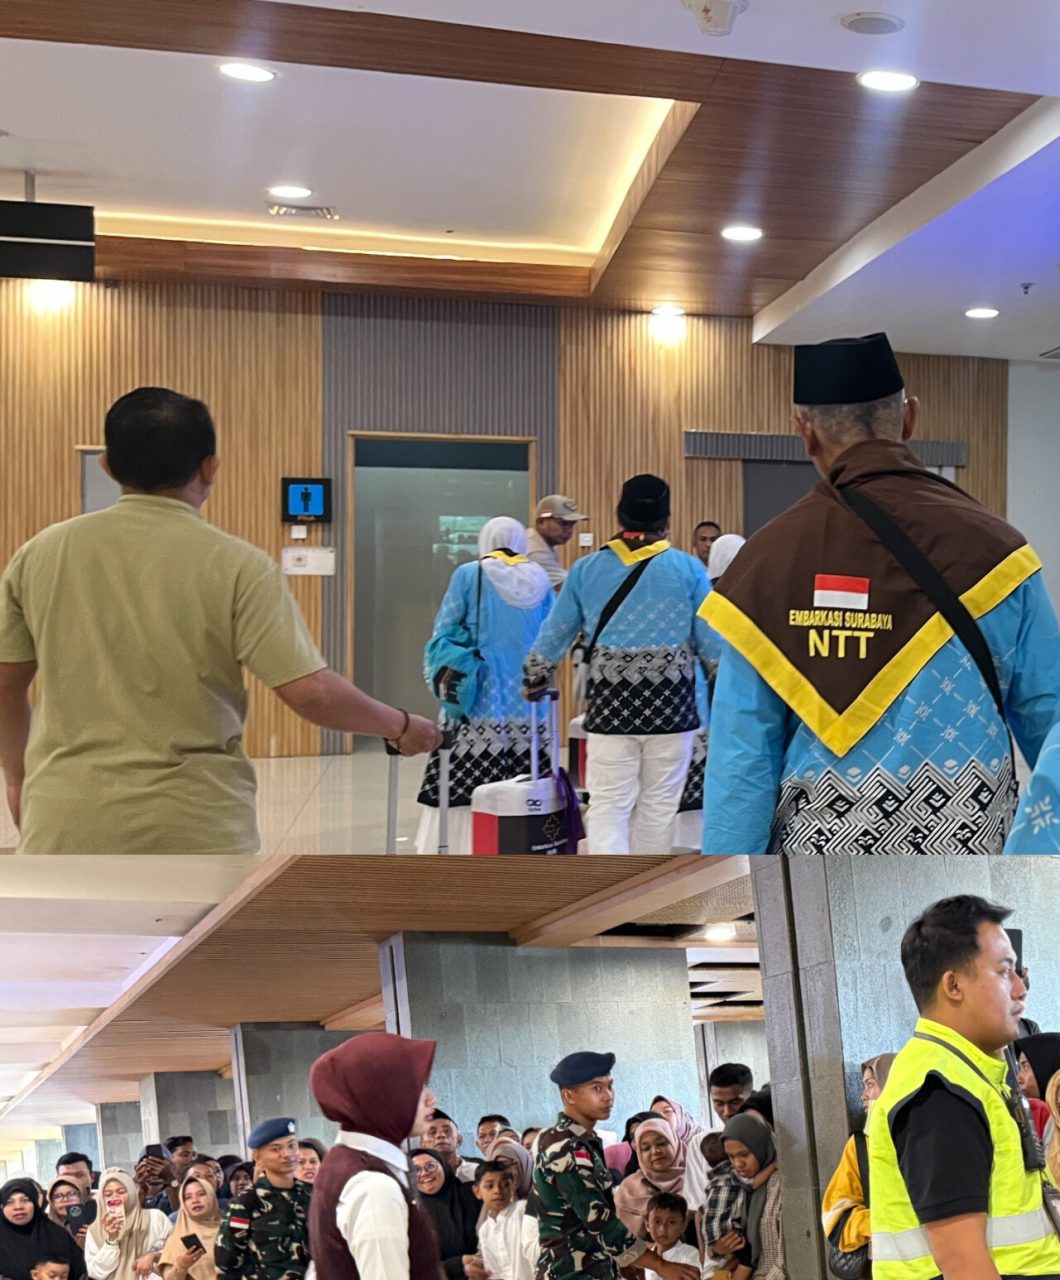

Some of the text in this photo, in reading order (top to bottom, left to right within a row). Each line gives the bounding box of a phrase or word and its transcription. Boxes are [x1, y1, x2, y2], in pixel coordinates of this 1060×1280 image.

[788, 609, 893, 630] EMBARKASI SURABAYA
[808, 628, 875, 659] NTT
